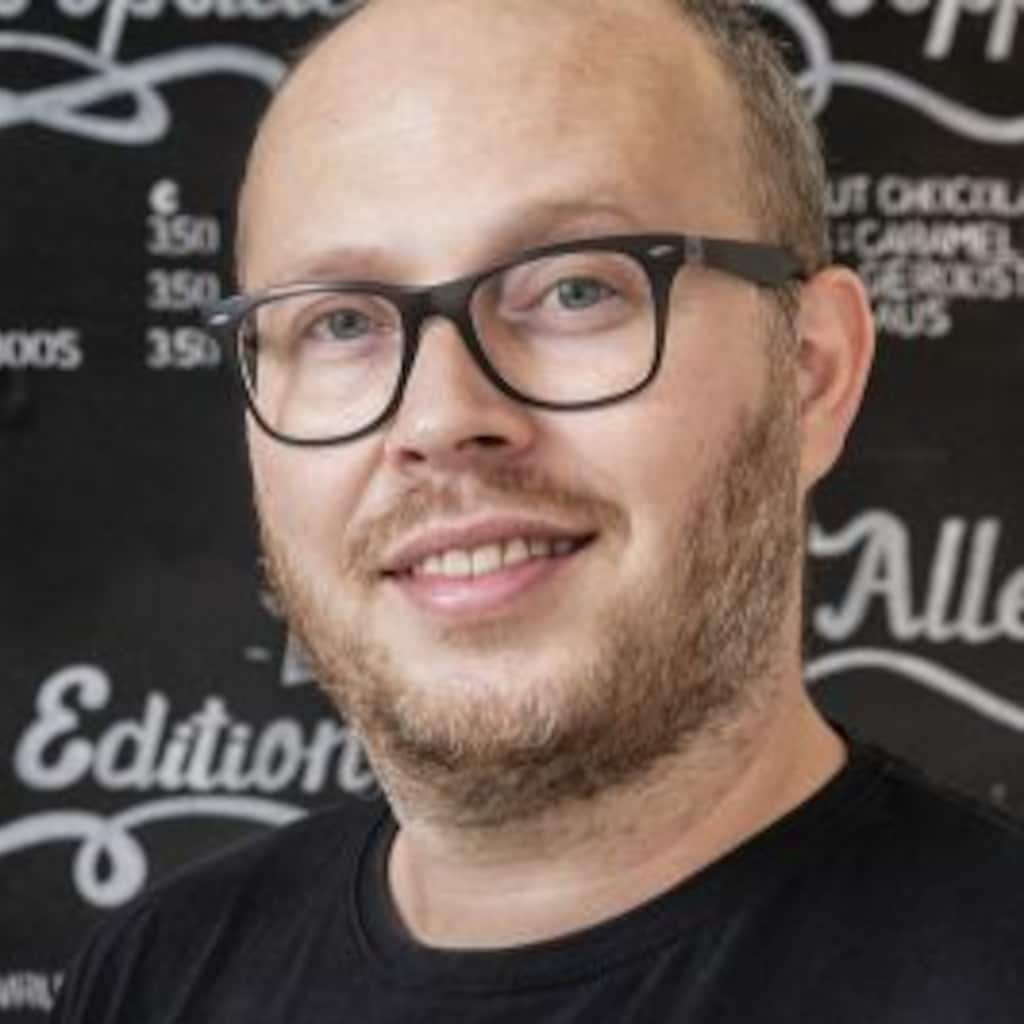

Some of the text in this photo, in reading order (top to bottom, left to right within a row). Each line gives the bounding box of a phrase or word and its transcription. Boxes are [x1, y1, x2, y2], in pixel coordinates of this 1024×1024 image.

[144, 213, 221, 257] 350
[144, 267, 221, 312] 350
[144, 326, 222, 370] 350
